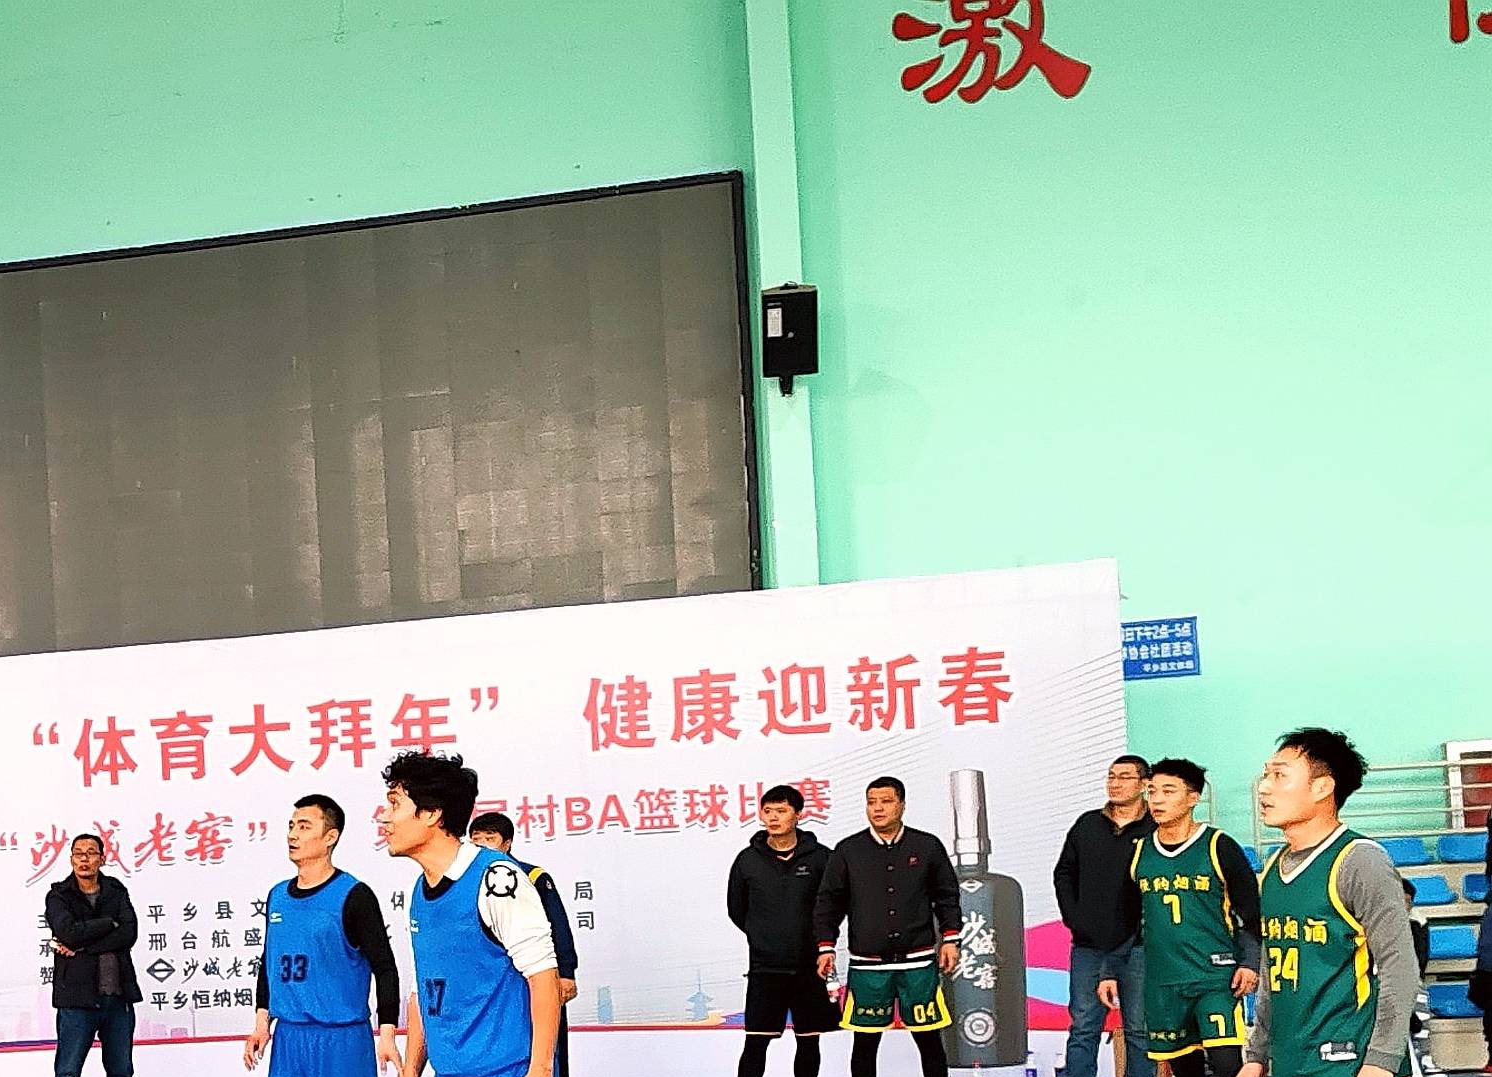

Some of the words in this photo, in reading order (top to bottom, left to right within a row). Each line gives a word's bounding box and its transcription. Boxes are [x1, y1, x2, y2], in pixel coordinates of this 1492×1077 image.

[582, 646, 1016, 752] 健康迎新春
[574, 881, 594, 901] 局
[576, 911, 595, 931] 司
[1163, 894, 1181, 924] 7
[279, 953, 308, 983] 33
[1268, 947, 1299, 992] 24
[913, 1001, 936, 1024] 04
[1209, 1014, 1226, 1036] 7
